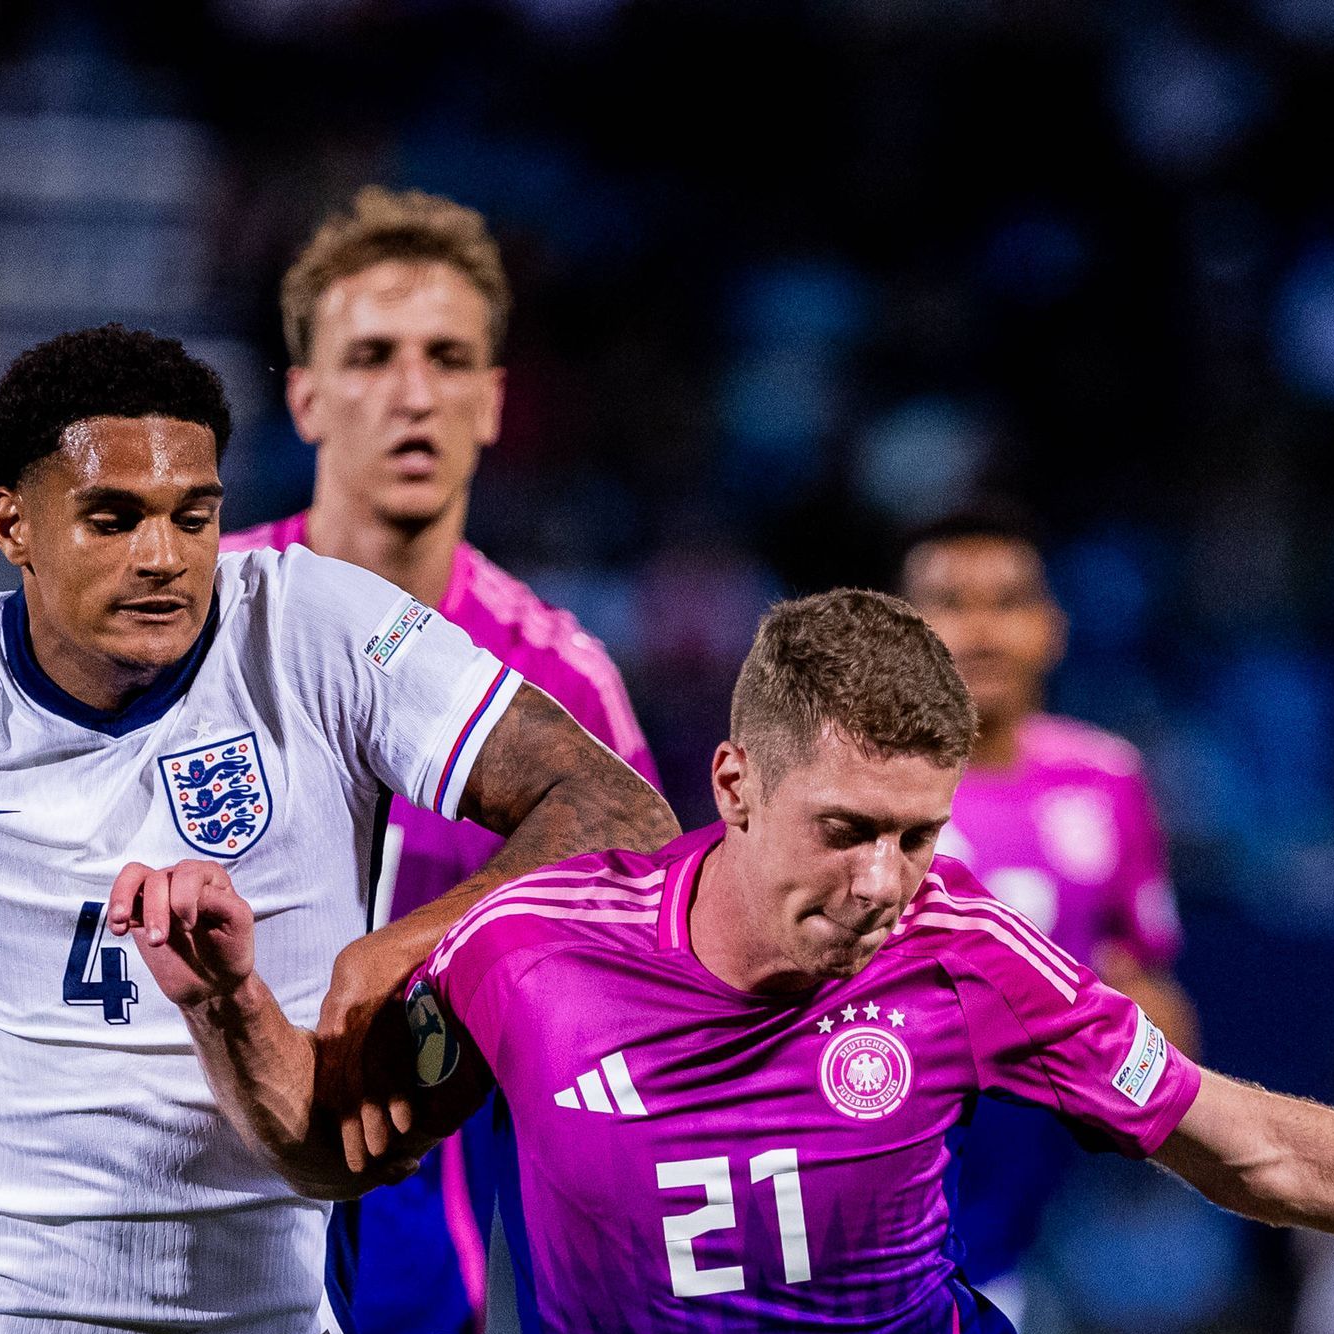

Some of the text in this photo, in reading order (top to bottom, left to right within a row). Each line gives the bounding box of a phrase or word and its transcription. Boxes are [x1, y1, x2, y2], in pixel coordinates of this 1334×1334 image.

[363, 635, 380, 655] UEFA
[373, 604, 423, 665] FOUNDATION
[63, 901, 138, 1025] 4
[839, 1039, 890, 1059] DEUTSCHER
[1116, 1066, 1132, 1087] UEFA
[655, 1148, 812, 1297] 21
